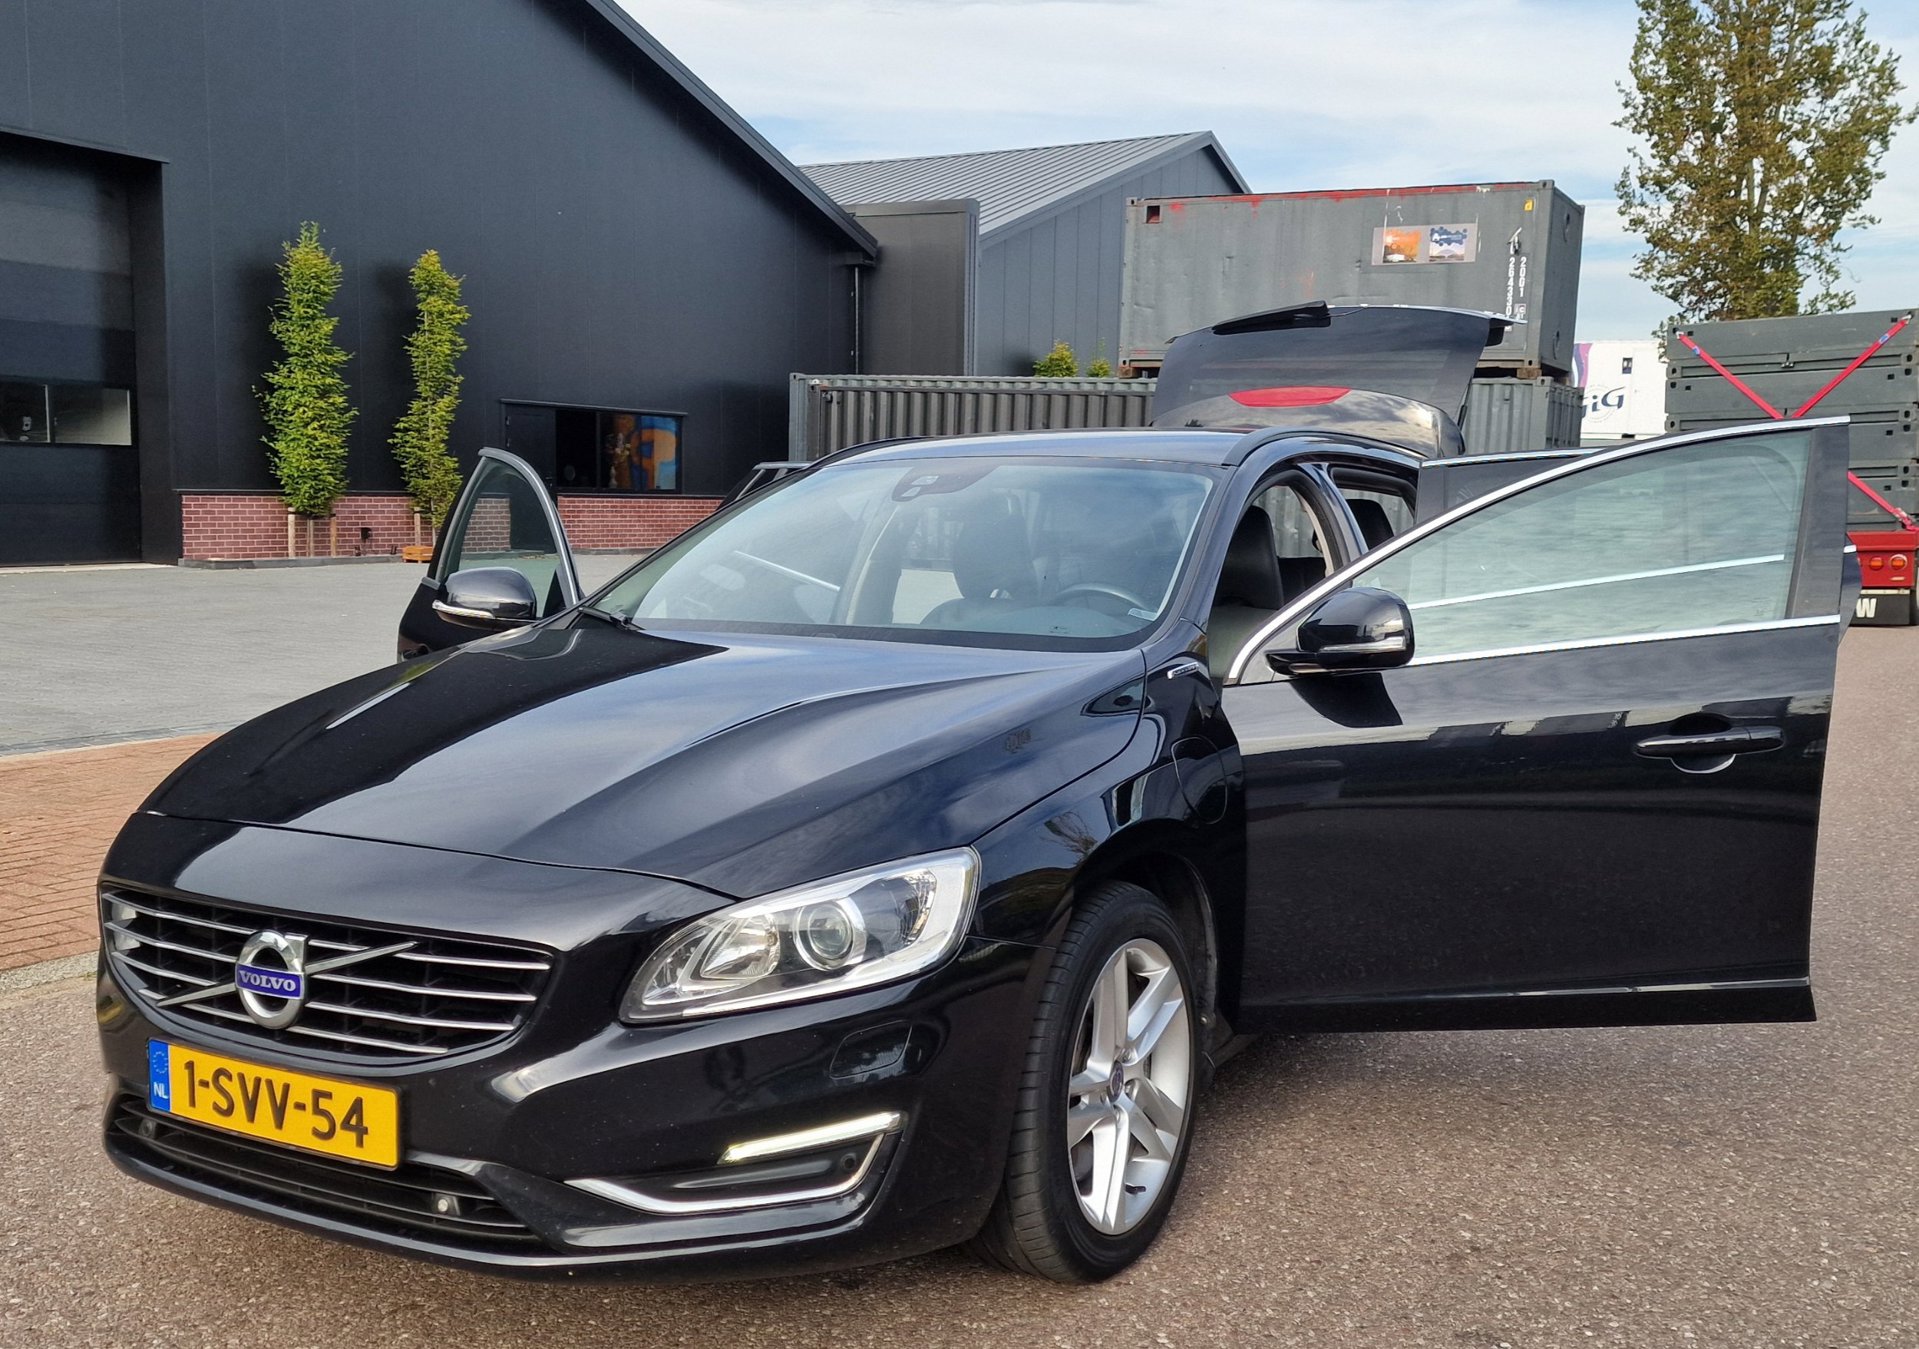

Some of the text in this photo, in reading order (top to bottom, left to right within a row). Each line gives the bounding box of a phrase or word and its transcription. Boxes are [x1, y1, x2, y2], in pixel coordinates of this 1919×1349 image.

[239, 970, 296, 992] VOLVO
[153, 1081, 169, 1099] NL
[184, 1060, 369, 1149] 1-SVV-54
